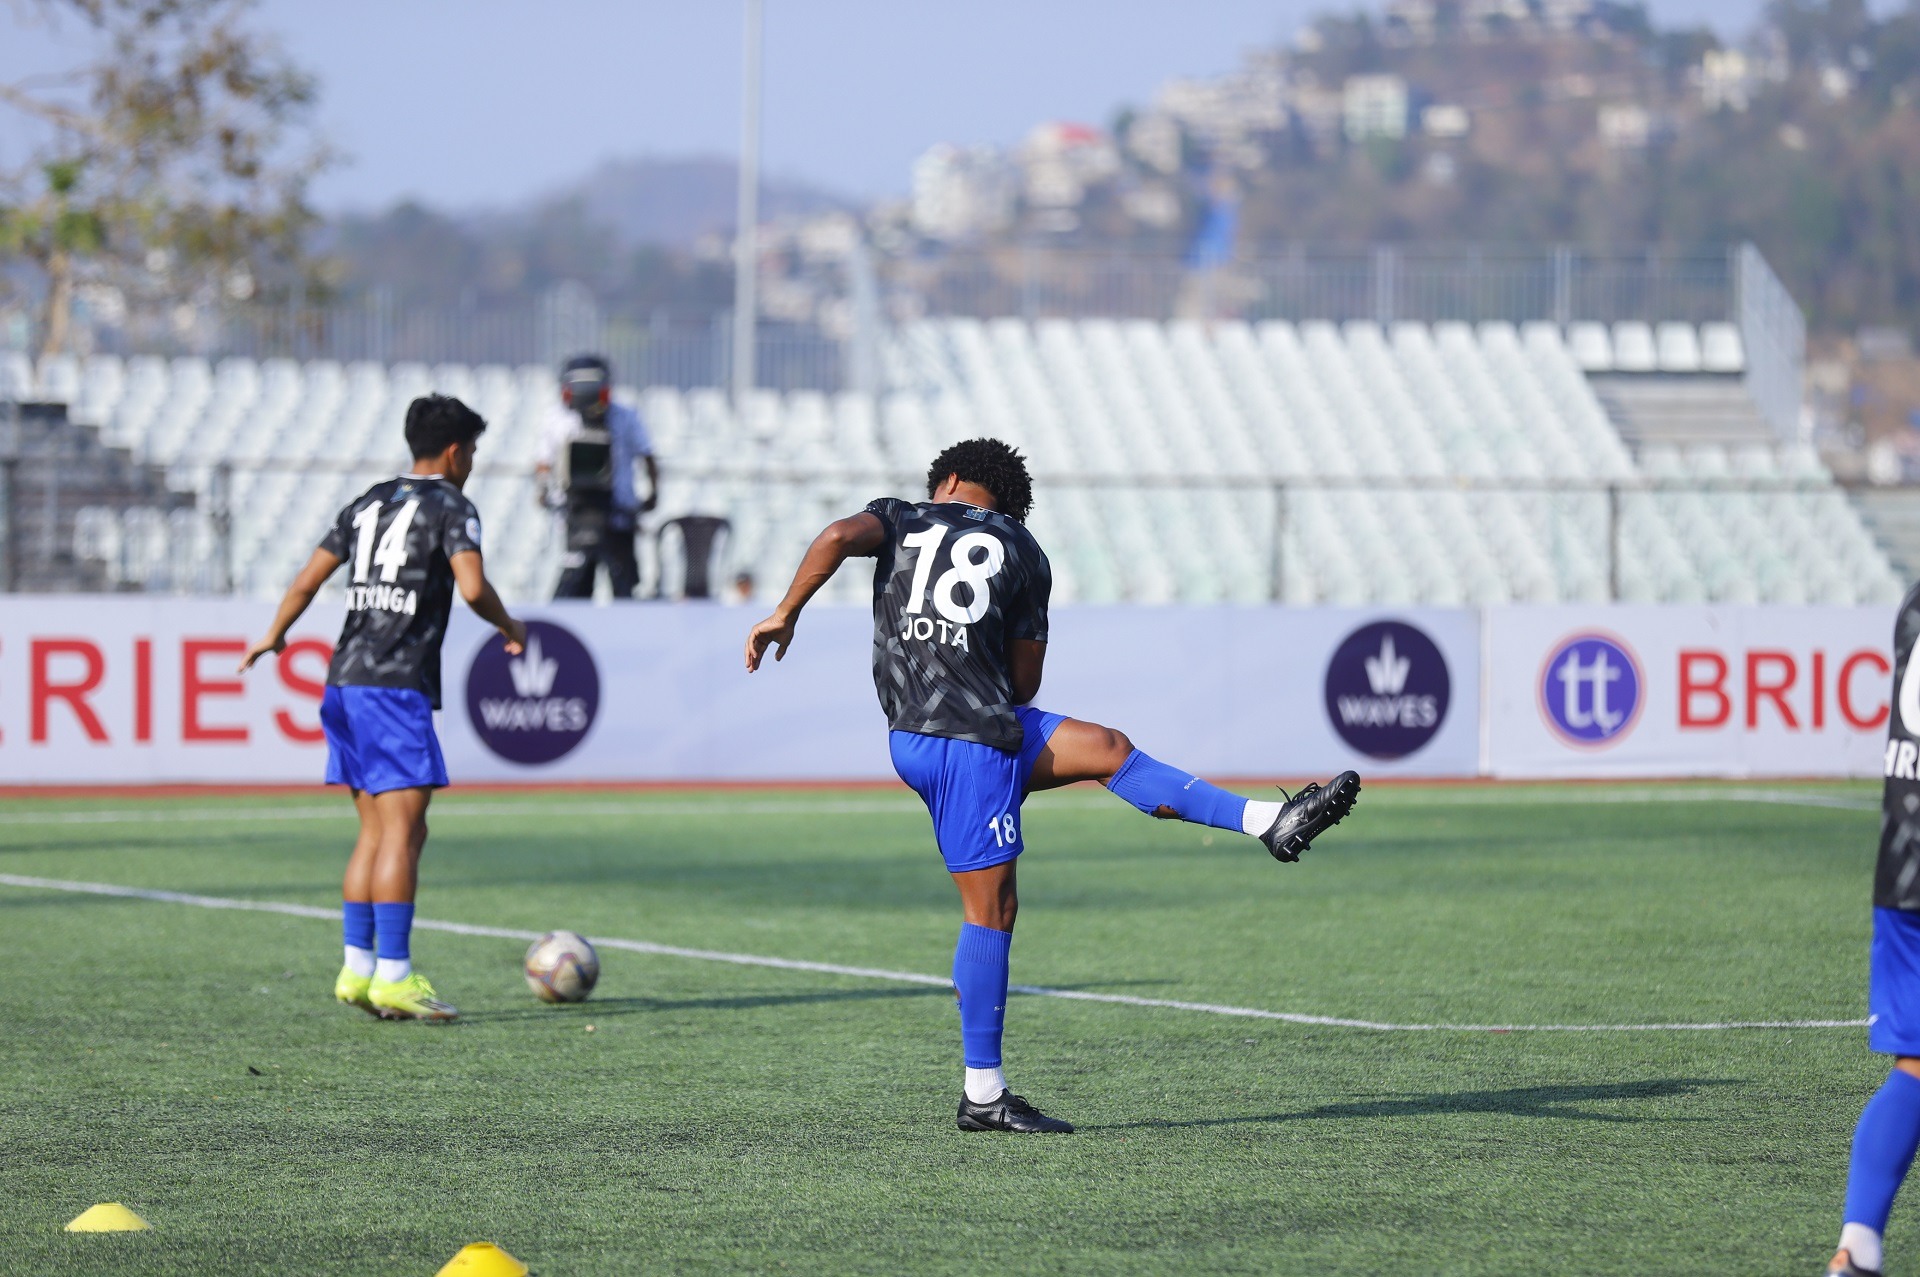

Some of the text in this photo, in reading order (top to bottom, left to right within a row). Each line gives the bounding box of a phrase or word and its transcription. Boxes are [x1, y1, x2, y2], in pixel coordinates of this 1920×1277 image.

[352, 500, 420, 583] 14
[902, 523, 1004, 624] 18
[902, 616, 969, 652] JOTA
[0, 637, 333, 745] RIES
[479, 697, 588, 731] WAVES
[1337, 695, 1438, 728] WAVES
[1677, 647, 1890, 732] BRIC
[988, 813, 1017, 848] 18
